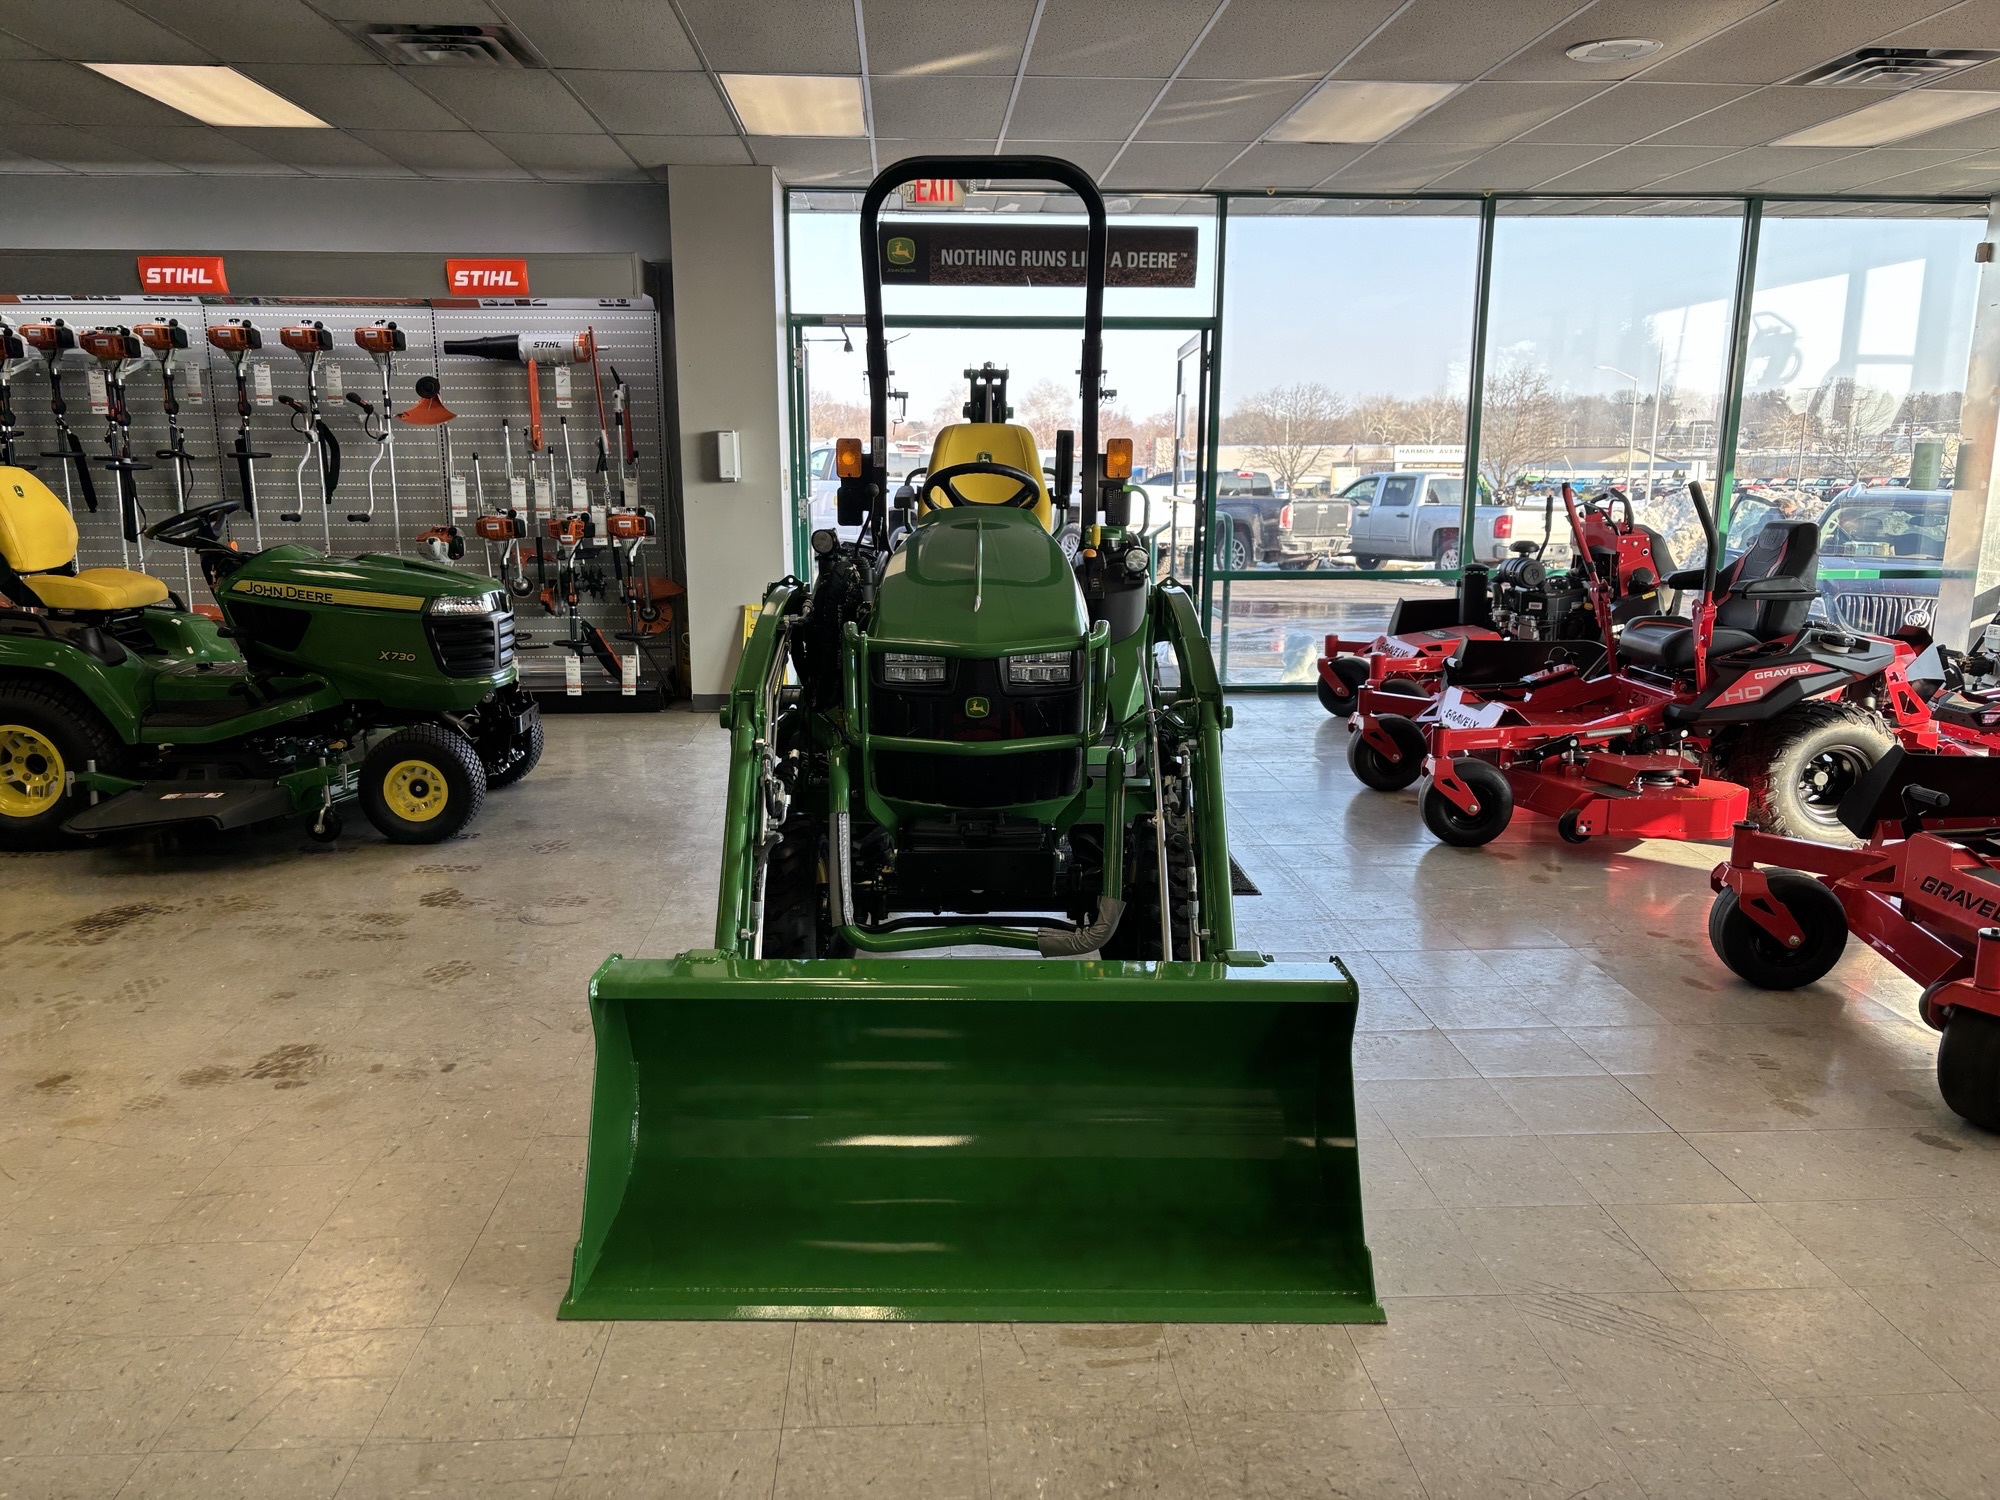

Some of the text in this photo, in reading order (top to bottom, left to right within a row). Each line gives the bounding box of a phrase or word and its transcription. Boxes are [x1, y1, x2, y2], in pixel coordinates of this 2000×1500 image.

[916, 178, 954, 202] EXIT
[940, 249, 1016, 267] NOTHING
[1021, 250, 1067, 267] RUNS
[1071, 250, 1087, 268] LI
[1110, 251, 1123, 268] A
[146, 267, 213, 284] STIHL
[454, 270, 519, 287] STIHL
[533, 341, 562, 349] STIHL
[245, 581, 334, 603] JOHN DEERE
[378, 651, 416, 662] X730
[1754, 665, 1811, 680] GRAVELY
[1724, 685, 1764, 702] HD
